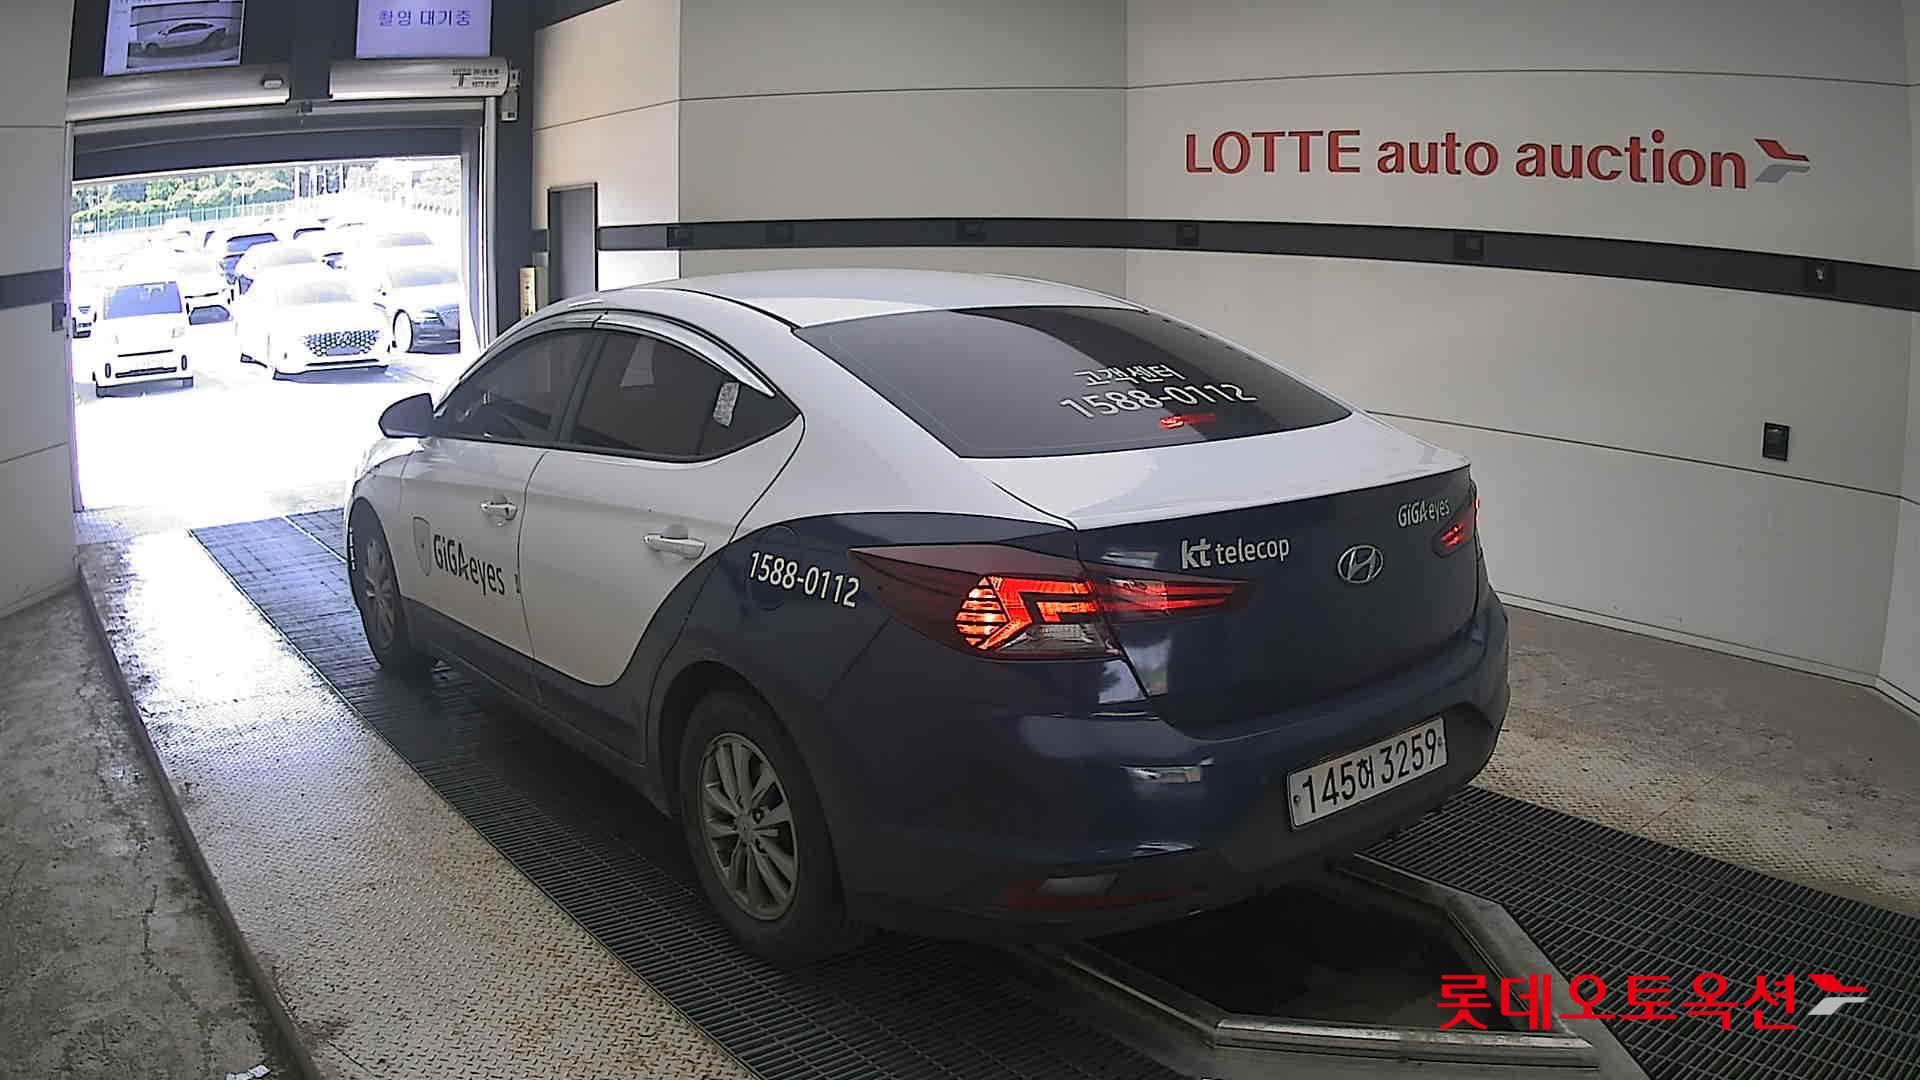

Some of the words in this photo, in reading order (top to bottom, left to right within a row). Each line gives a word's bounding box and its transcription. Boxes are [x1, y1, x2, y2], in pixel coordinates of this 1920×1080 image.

[420, 9, 470, 26] 대기중
[1185, 129, 1361, 175] LOTTE
[1376, 131, 1500, 177] auto
[1516, 129, 1747, 189] auction
[1073, 364, 1186, 386] 고객센터
[1060, 383, 1257, 418] 1588-0112
[1181, 538, 1211, 569] kt
[1215, 537, 1290, 565] telecop
[749, 551, 860, 608] 1588-0112
[1379, 728, 1437, 784] 3259
